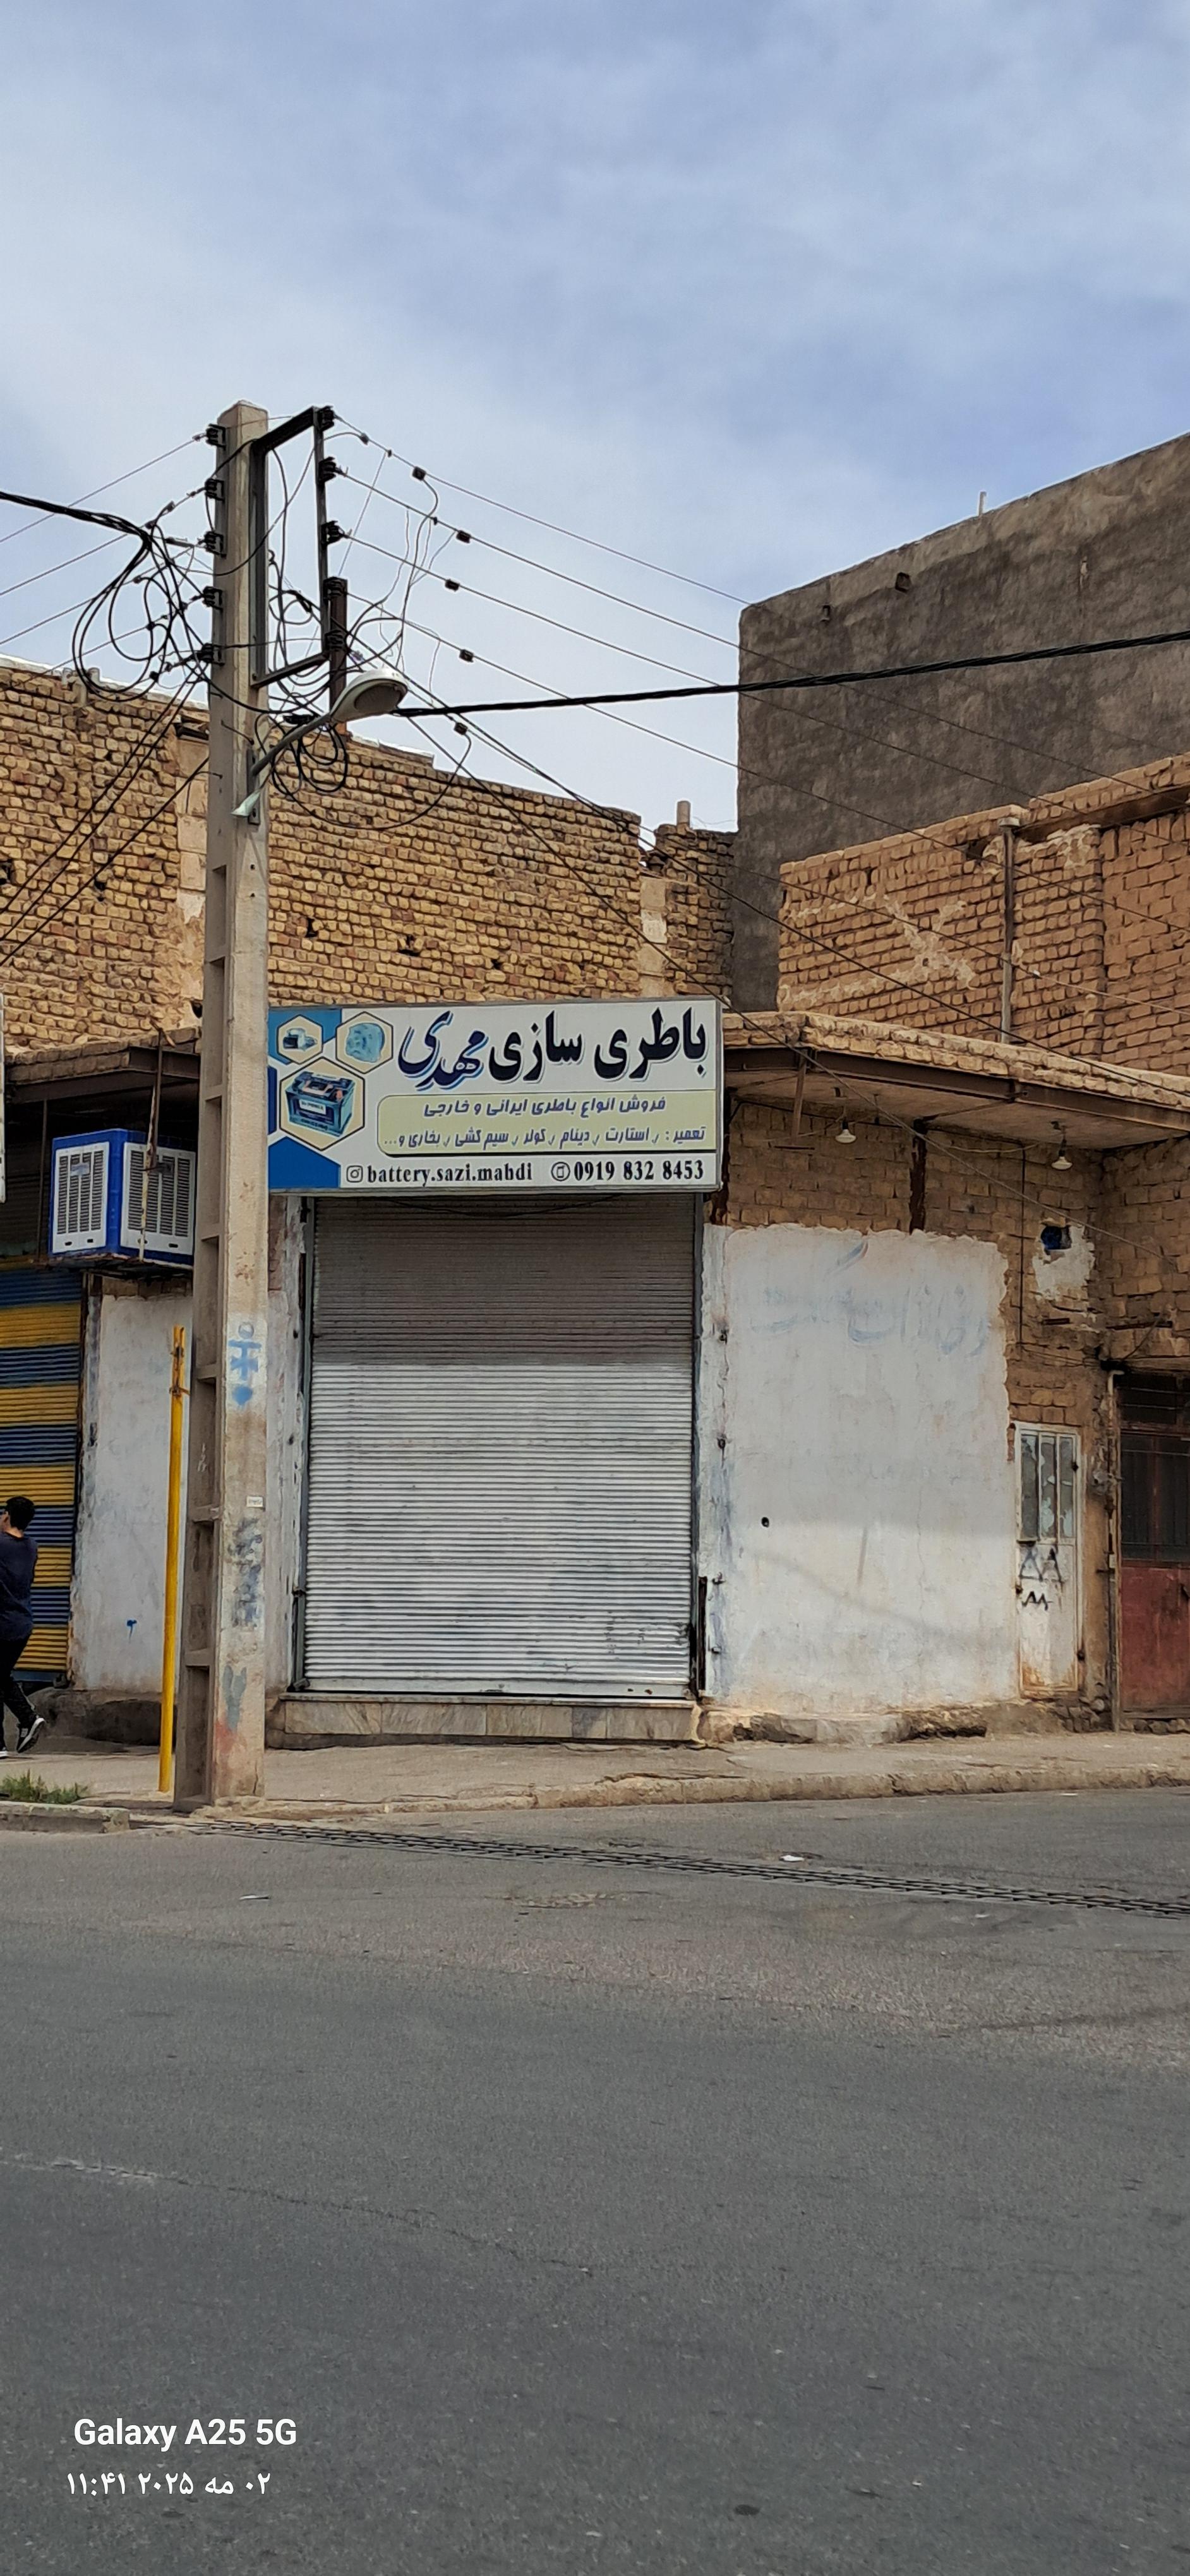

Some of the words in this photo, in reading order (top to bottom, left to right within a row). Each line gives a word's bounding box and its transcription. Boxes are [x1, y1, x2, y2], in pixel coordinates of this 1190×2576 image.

[398, 1010, 488, 1090] مهدی
[489, 1010, 582, 1081] سازی
[594, 1006, 706, 1079] باطری
[424, 1100, 469, 1118] خارجی
[474, 1102, 481, 1116] و
[486, 1099, 528, 1116] ایرانی
[531, 1097, 576, 1115] باطری
[580, 1097, 615, 1118] انواع
[619, 1094, 666, 1113] فروش
[408, 1130, 441, 1148] بخاری
[455, 1126, 481, 1147] کشی
[483, 1132, 508, 1151] سیم
[523, 1129, 546, 1145] کولر
[560, 1128, 590, 1149] دینام
[606, 1126, 649, 1144] استارت
[673, 1126, 706, 1144] تعمیر
[367, 1162, 532, 1187] battery.sazi.mahdi
[574, 1161, 615, 1181] 0919
[623, 1160, 654, 1181] 832
[663, 1160, 704, 1180] 8453
